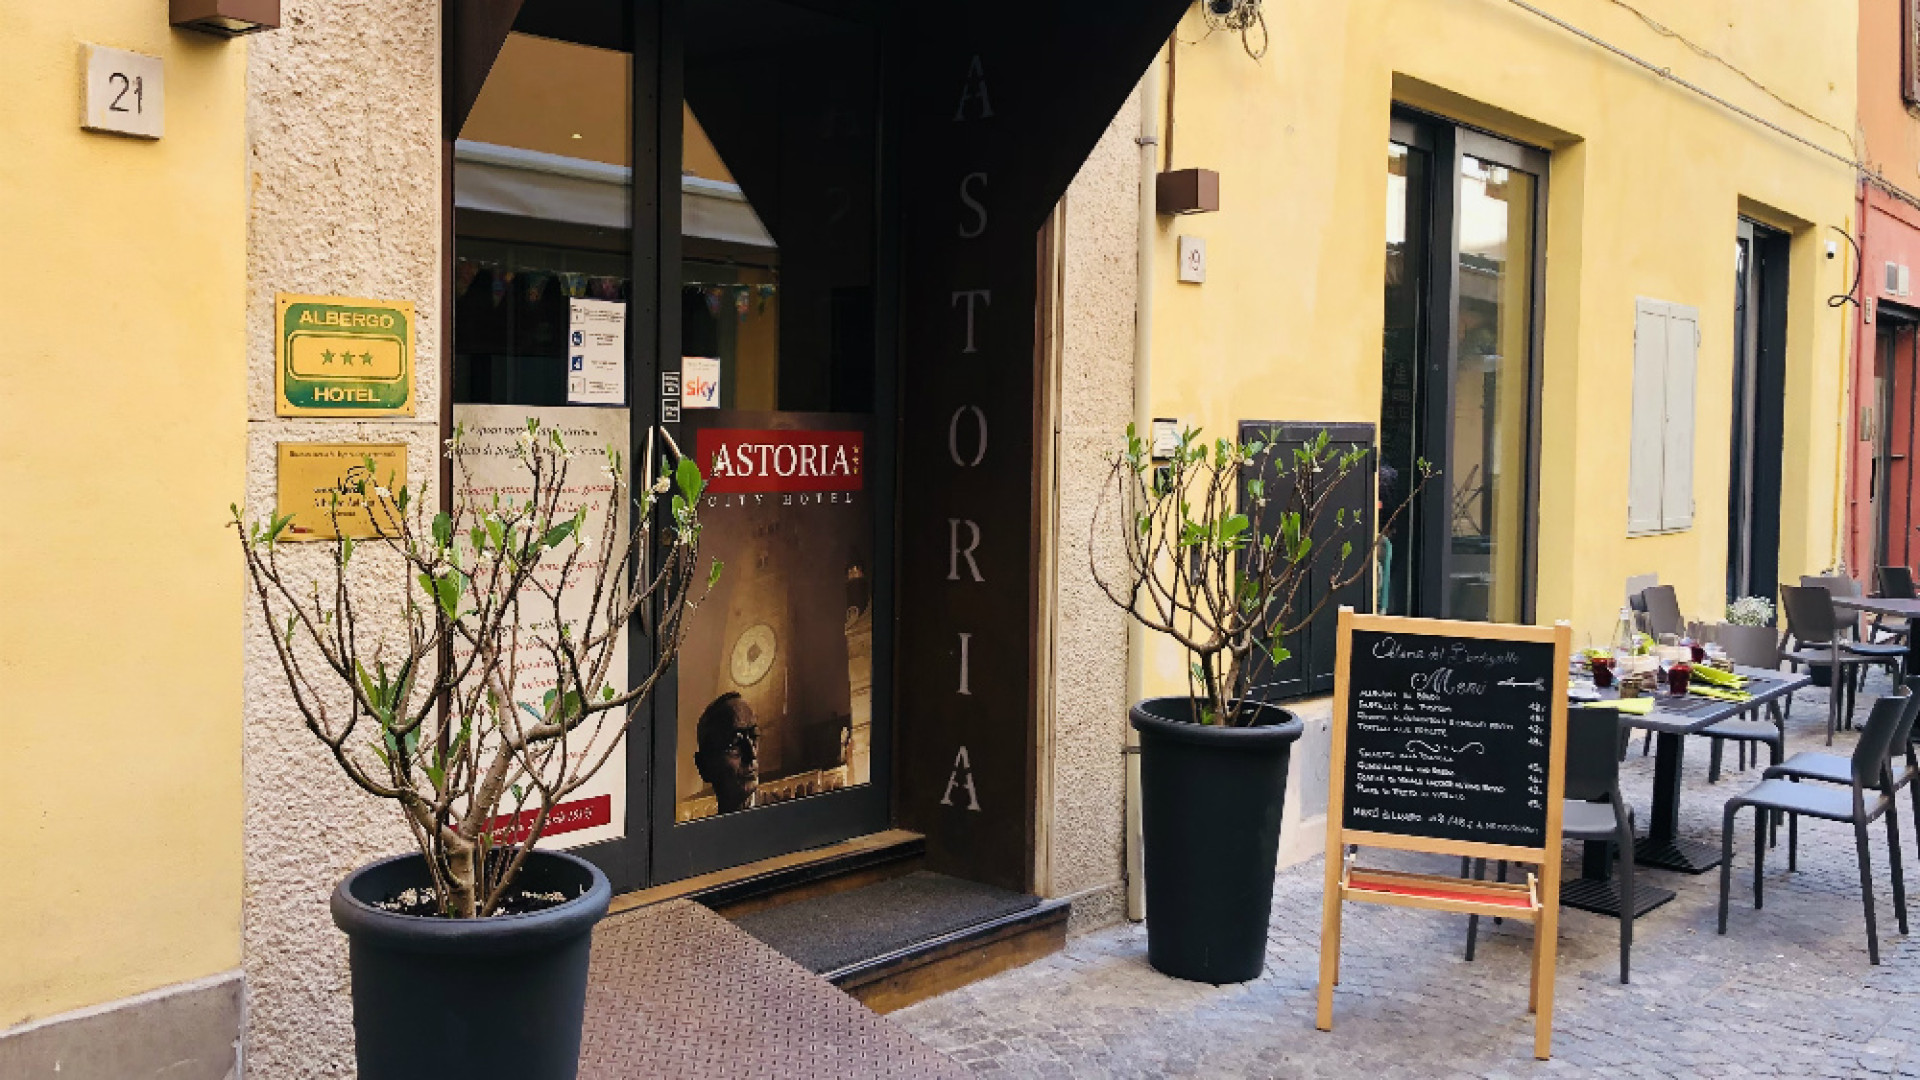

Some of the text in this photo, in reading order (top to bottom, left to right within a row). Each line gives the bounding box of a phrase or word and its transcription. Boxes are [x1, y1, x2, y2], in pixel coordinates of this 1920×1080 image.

[107, 71, 144, 114] 21
[298, 308, 396, 330] ALBERGO
[313, 385, 382, 405] HOTEL
[686, 376, 717, 402] sky
[940, 54, 995, 812] ASTORIA
[712, 442, 851, 478] ASTORIA
[707, 492, 854, 508] CITY HOTEL
